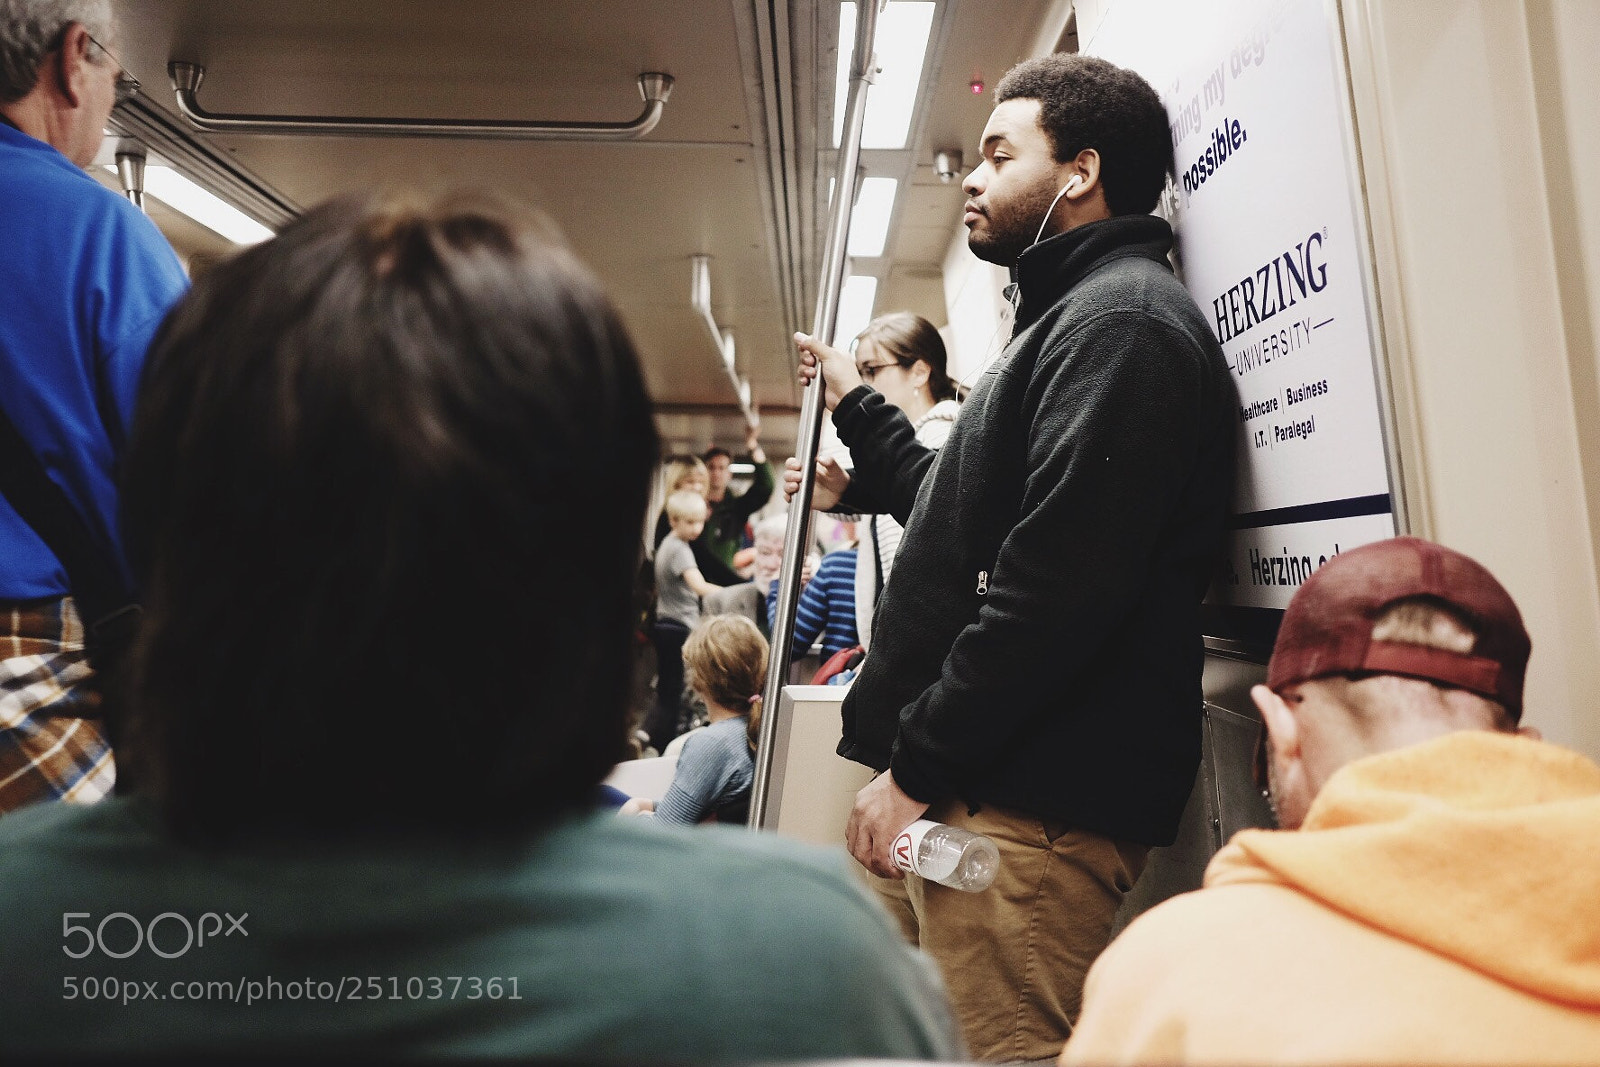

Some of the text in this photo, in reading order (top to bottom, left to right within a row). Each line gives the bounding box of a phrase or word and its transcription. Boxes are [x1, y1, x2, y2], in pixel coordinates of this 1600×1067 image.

[1203, 60, 1226, 112] my
[1183, 118, 1247, 207] possible.
[1213, 232, 1328, 346] HERZING
[1236, 317, 1311, 377] UNIVERSITY
[1286, 379, 1328, 406] Business
[1255, 415, 1316, 448] I.T. Paralegal
